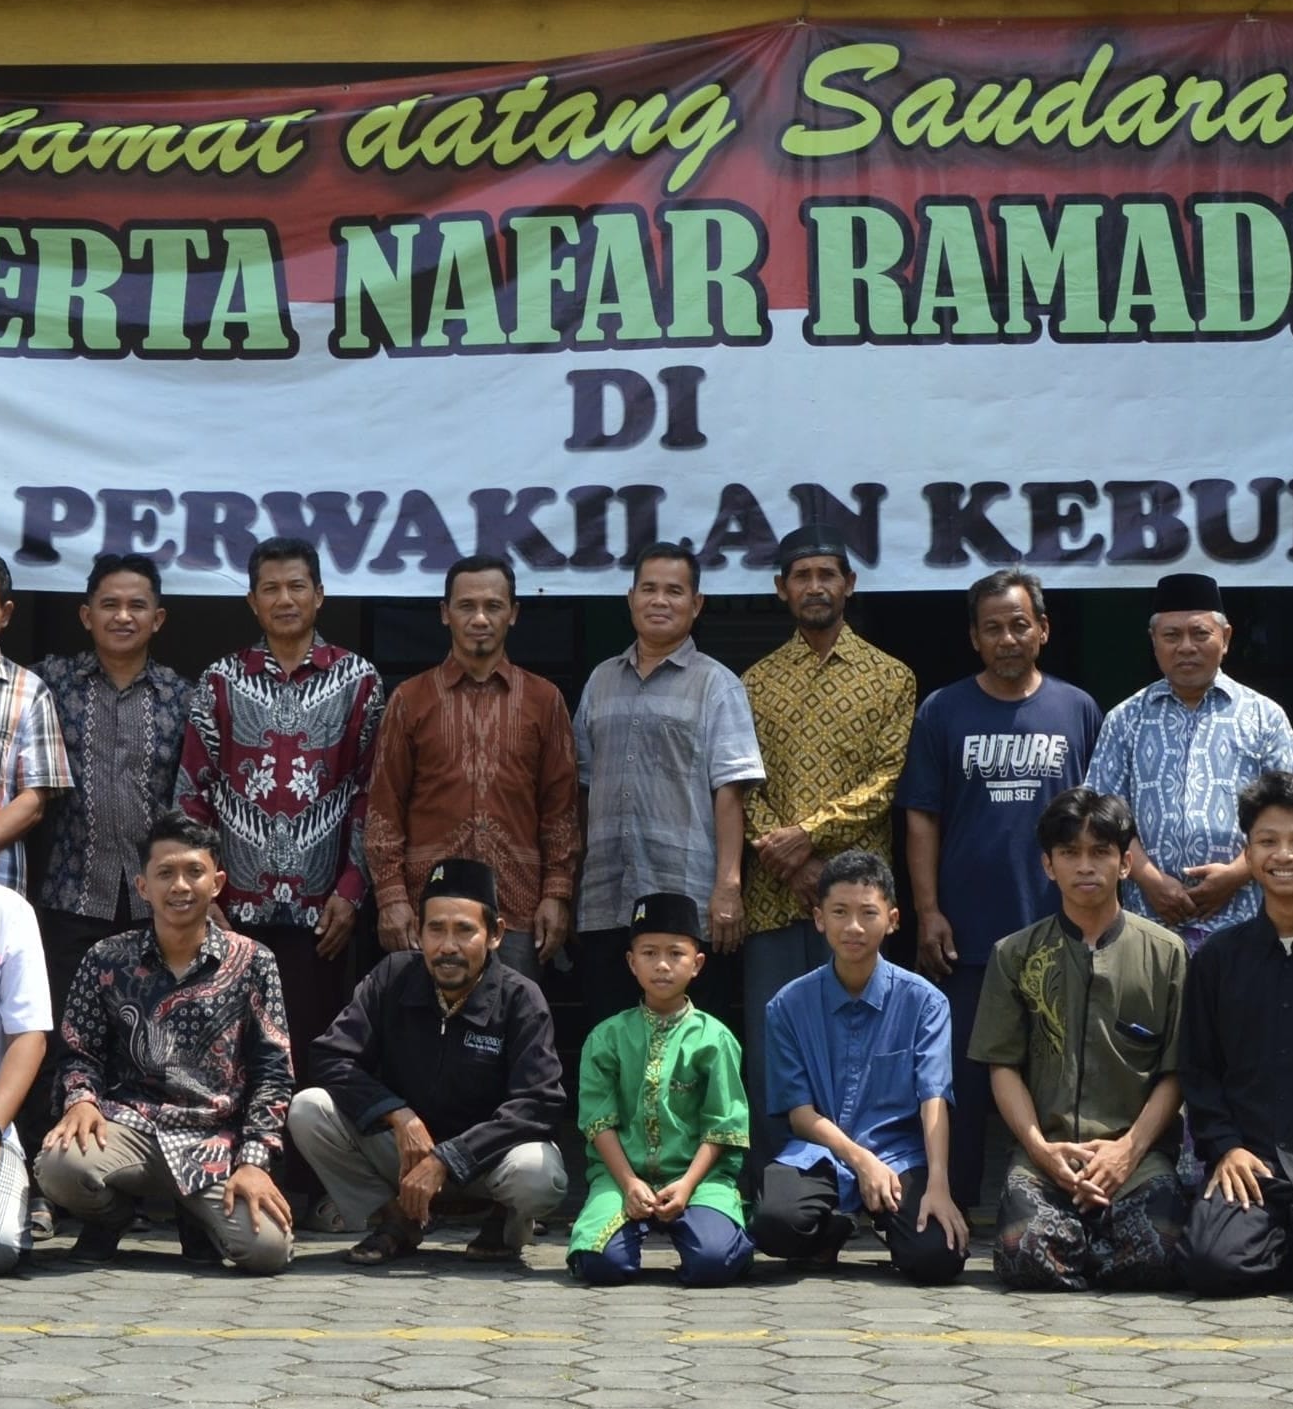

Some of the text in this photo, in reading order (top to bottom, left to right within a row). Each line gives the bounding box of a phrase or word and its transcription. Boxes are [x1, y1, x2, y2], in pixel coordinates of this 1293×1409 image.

[346, 74, 737, 192] datang
[331, 201, 772, 358] NAFAR
[562, 365, 708, 452] DI
[14, 481, 889, 572] PERWAKILAN
[962, 733, 1069, 779] FUTURE
[989, 788, 1037, 803] YOUR SELF
